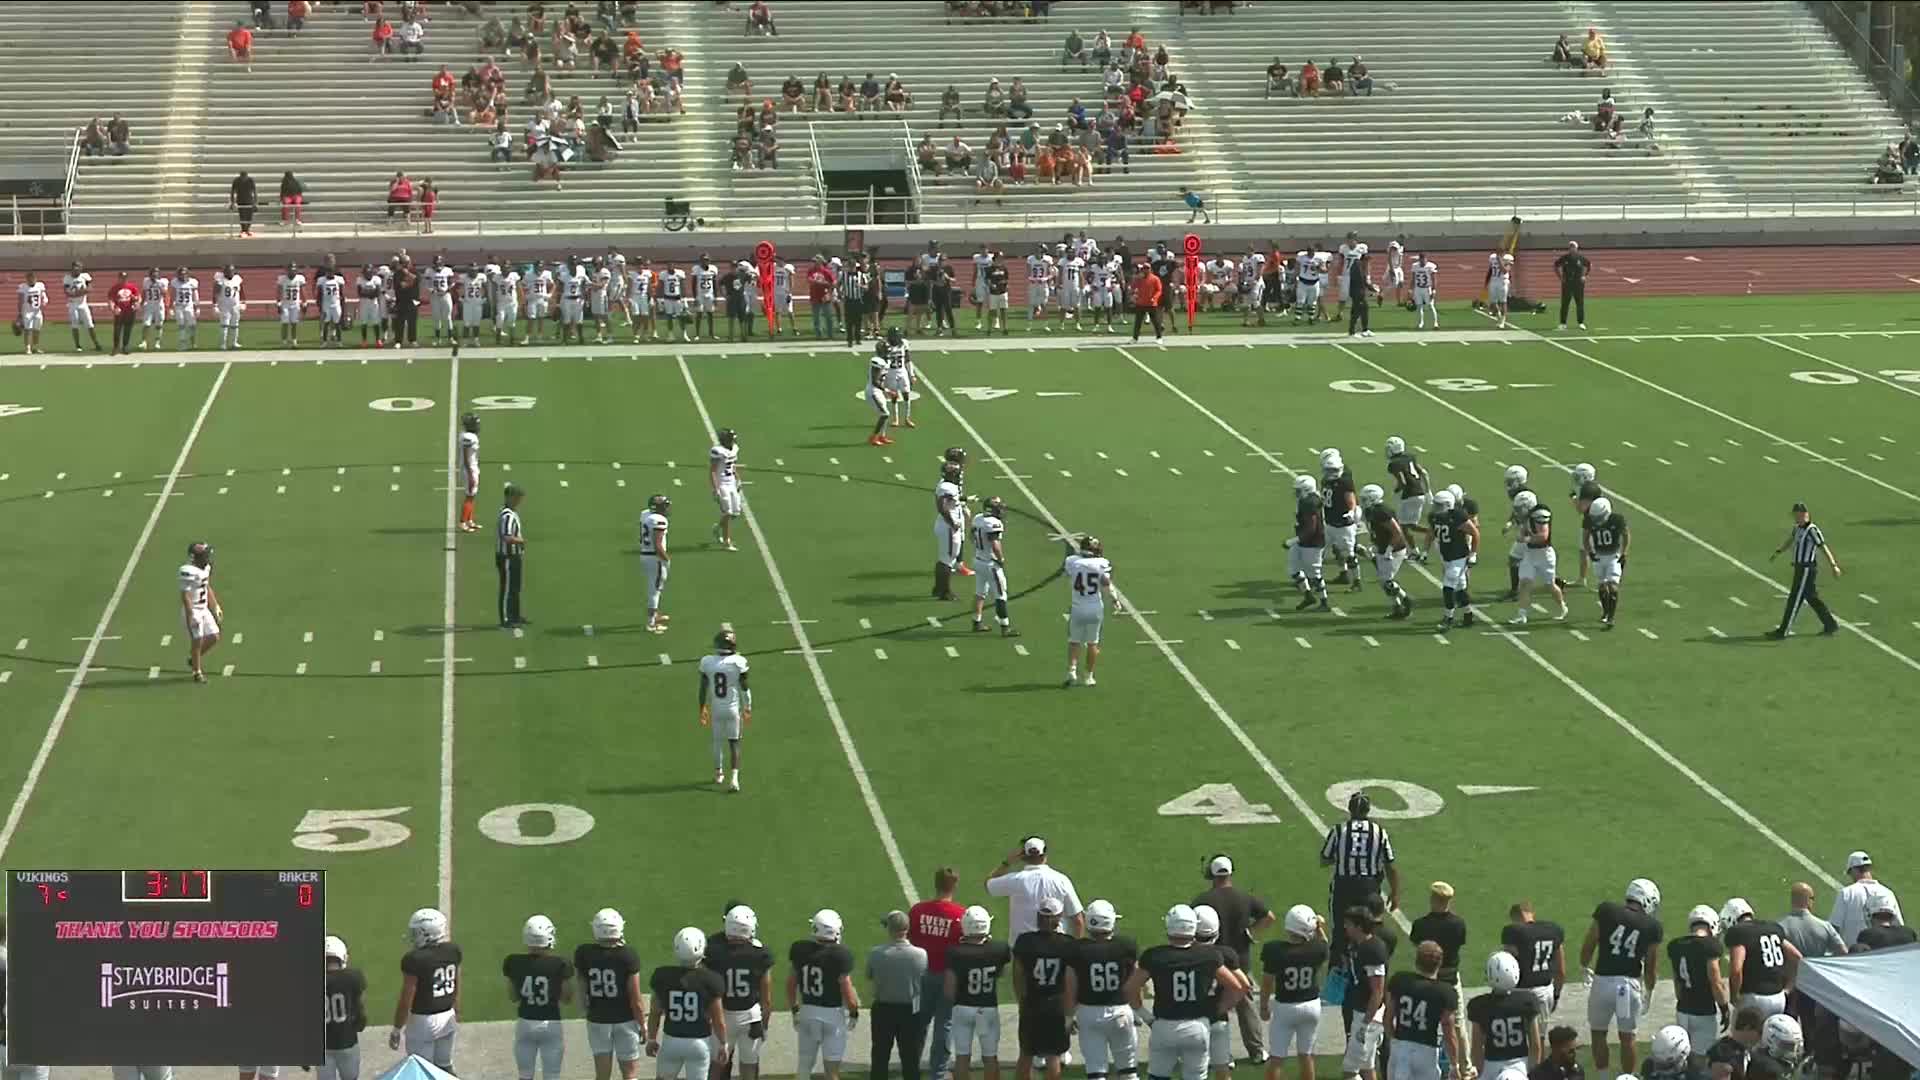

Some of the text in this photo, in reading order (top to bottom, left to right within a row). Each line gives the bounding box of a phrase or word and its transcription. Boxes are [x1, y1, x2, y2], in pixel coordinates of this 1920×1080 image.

[1597, 530, 1612, 545] 10
[1074, 571, 1099, 596] 45
[714, 672, 728, 698] 8
[1157, 779, 1445, 824] 4 0
[291, 803, 596, 852] 5 0
[920, 913, 953, 929] EVENT
[1532, 940, 1553, 972] 17
[1609, 924, 1640, 958] 44
[1759, 934, 1784, 967] 86
[588, 967, 618, 998] 28
[726, 967, 750, 998] 15
[801, 964, 824, 997] 13
[968, 965, 996, 995] 85
[1033, 957, 1060, 986] 47
[1089, 961, 1120, 992] 66
[1172, 970, 1196, 1001] 61
[1284, 966, 1313, 991] 38
[520, 975, 550, 1006] 43
[668, 990, 698, 1023] 59
[1399, 995, 1428, 1031] 24
[1491, 1016, 1522, 1048] 95
